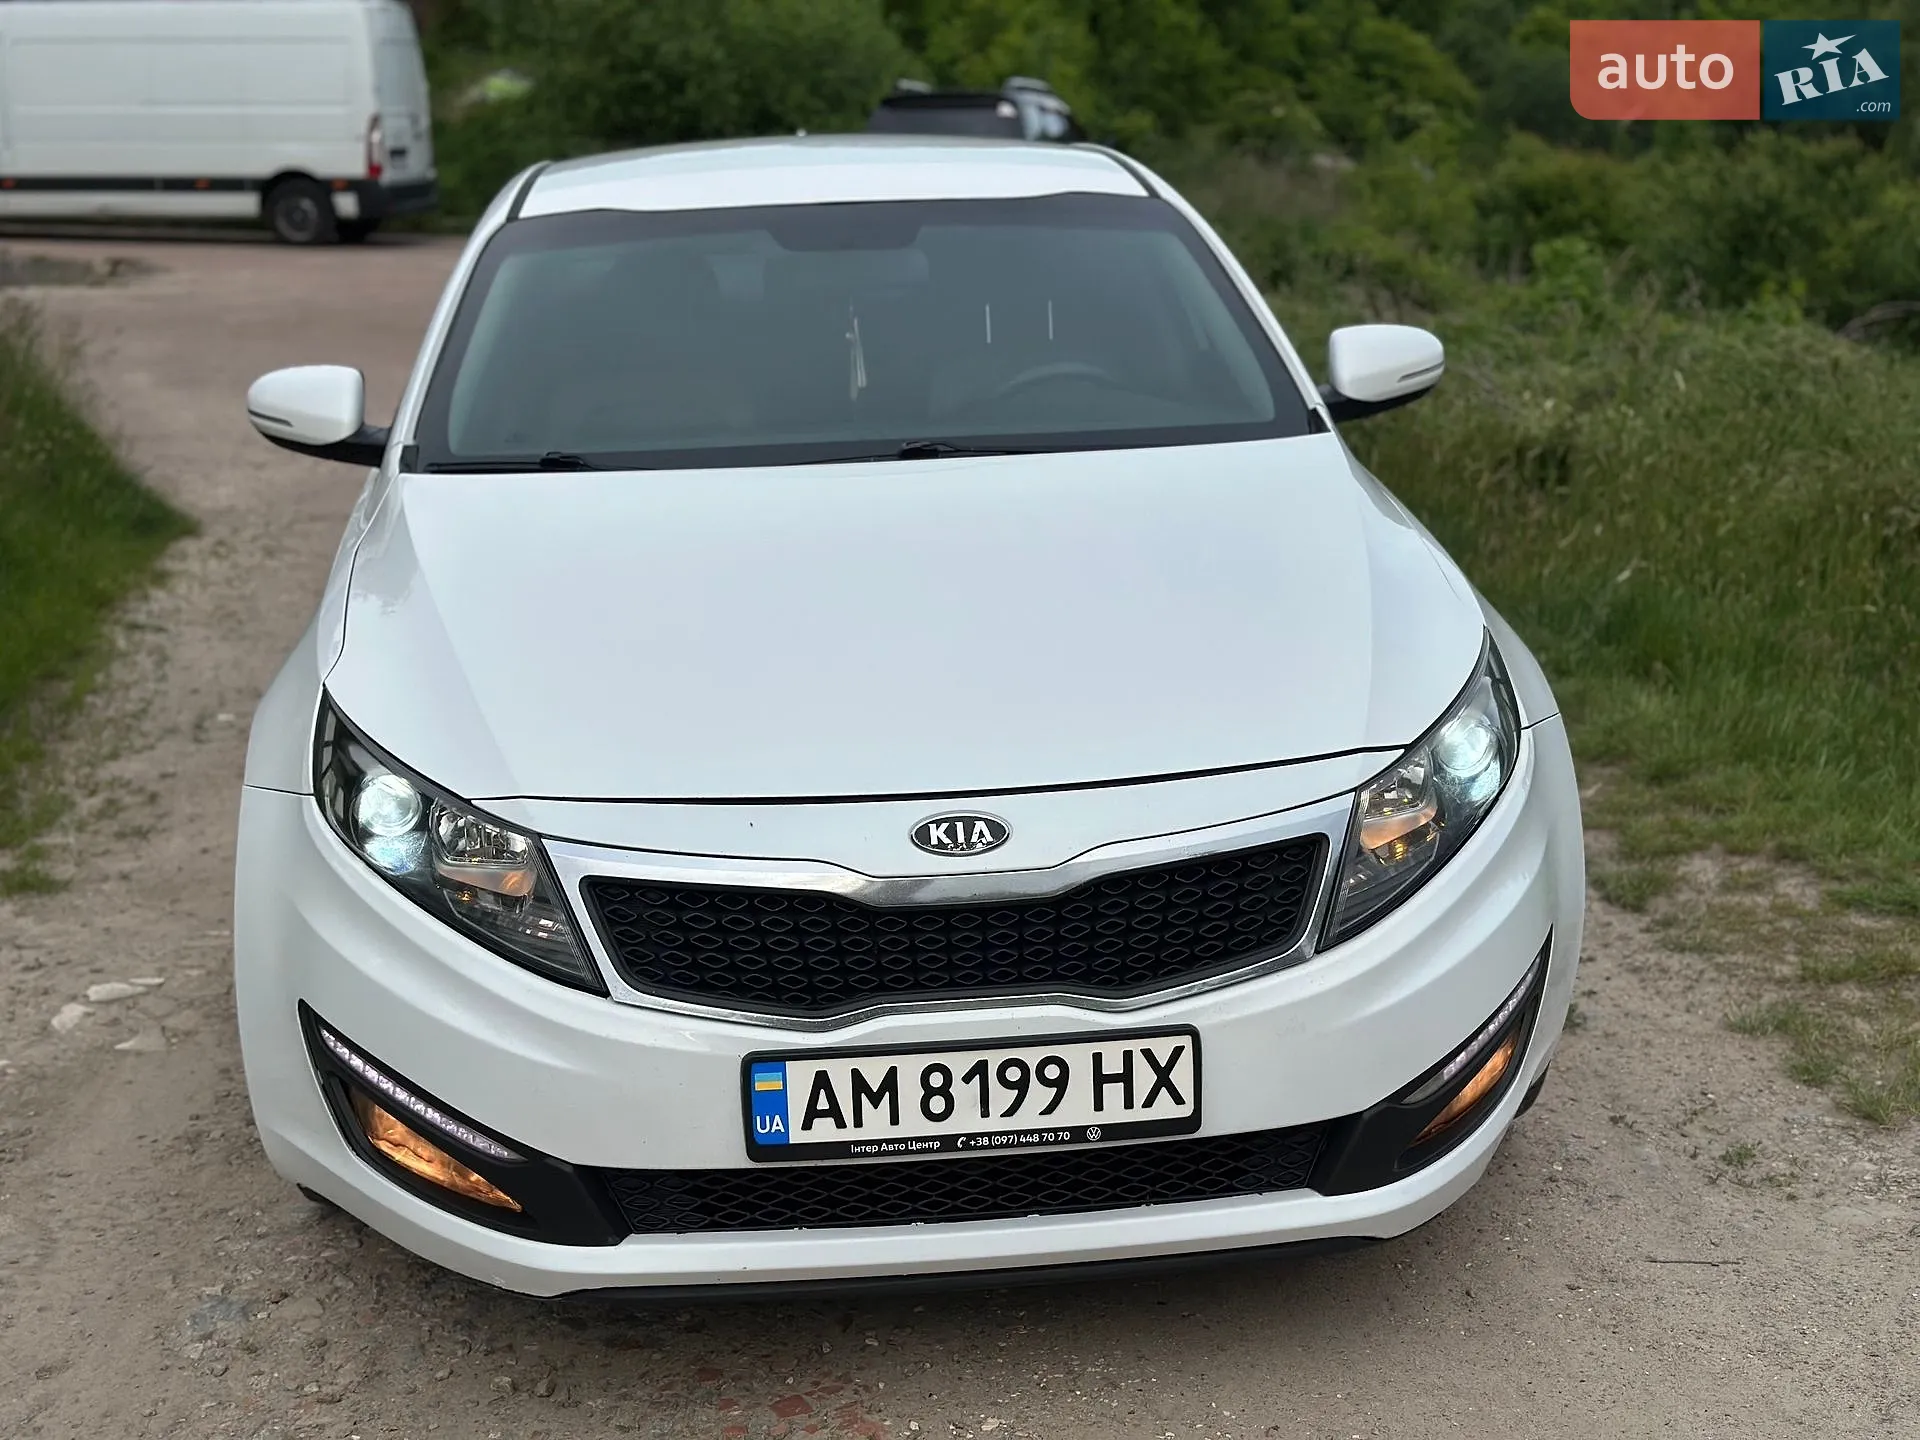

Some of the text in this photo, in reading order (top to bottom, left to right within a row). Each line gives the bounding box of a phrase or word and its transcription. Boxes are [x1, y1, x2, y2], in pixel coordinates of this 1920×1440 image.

[928, 820, 994, 845] KIA
[800, 1045, 1187, 1131] AM 8199 HX
[755, 1114, 786, 1134] UA
[850, 1140, 941, 1155] Інтер Авто Центр
[969, 1131, 1071, 1147] +38 (097) 448 70 70
